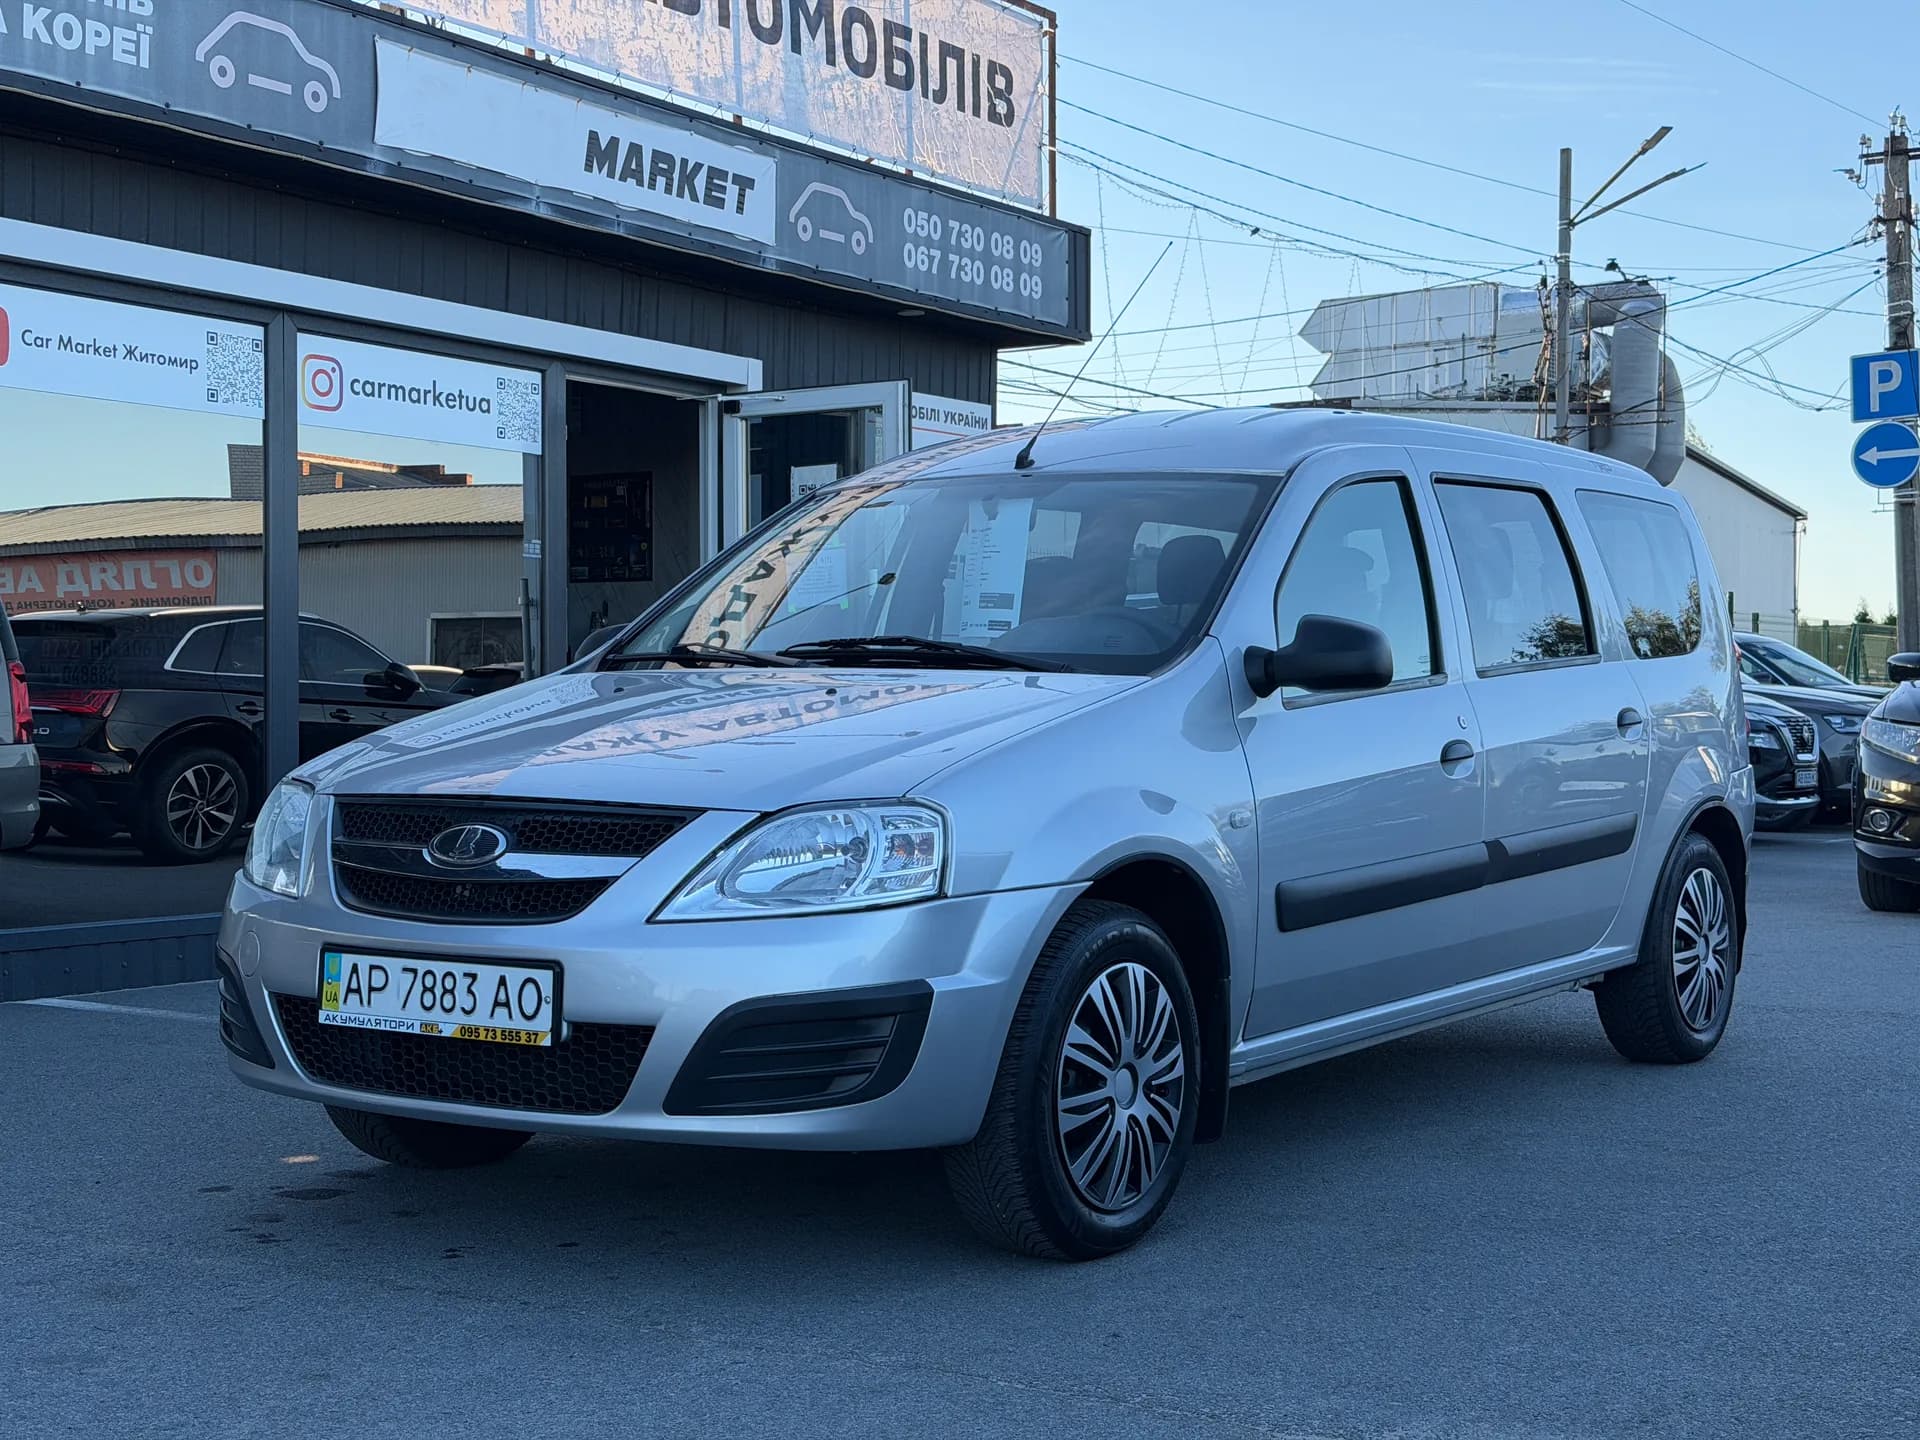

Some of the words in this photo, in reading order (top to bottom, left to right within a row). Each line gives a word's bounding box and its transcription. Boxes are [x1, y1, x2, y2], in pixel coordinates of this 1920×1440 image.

[22, 2, 153, 69] КОРЕЇ
[648, 0, 1015, 128] ОМОБІЛІВ
[584, 130, 756, 215] MARKET
[903, 207, 942, 241] 050
[949, 220, 984, 252] 730
[991, 232, 1014, 260] 08
[1020, 240, 1043, 267] 09
[903, 242, 942, 274] 067
[949, 253, 984, 285] 730
[991, 265, 1014, 293] 08
[1020, 272, 1043, 300] 09
[21, 328, 52, 349] Car
[57, 334, 118, 360] Market
[122, 343, 199, 374] Житомир
[350, 378, 491, 414] carmarketua
[1869, 360, 1902, 413] P
[943, 410, 988, 430] УКРАЇНИ
[325, 990, 338, 1003] UA
[343, 963, 389, 1007] AP
[401, 967, 478, 1015] 7883
[490, 975, 543, 1021] AO
[323, 1014, 415, 1031] АКУМУЛЯТОРИ
[460, 1026, 481, 1038] 095
[484, 1028, 497, 1040] 73
[501, 1030, 522, 1042] 555
[524, 1032, 539, 1044] 37
